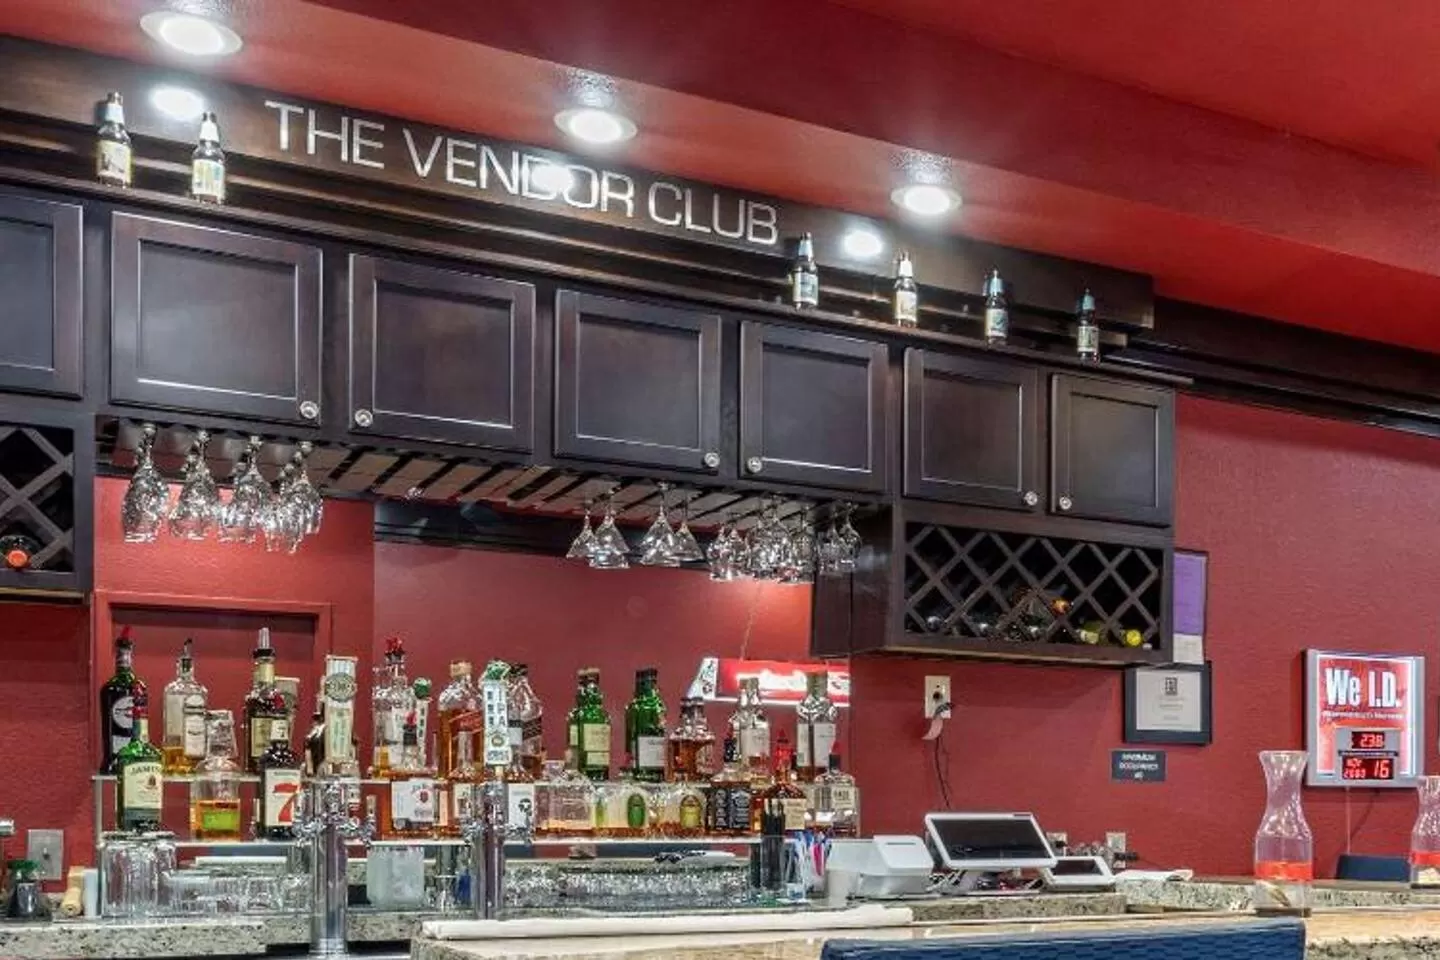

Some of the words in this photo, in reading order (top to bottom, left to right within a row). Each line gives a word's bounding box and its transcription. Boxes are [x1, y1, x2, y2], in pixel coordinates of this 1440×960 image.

[265, 99, 385, 170] THE
[402, 128, 635, 218] VENDOR
[648, 180, 779, 246] CLUB
[1325, 668, 1361, 707] We
[1368, 670, 1401, 708] I.D.
